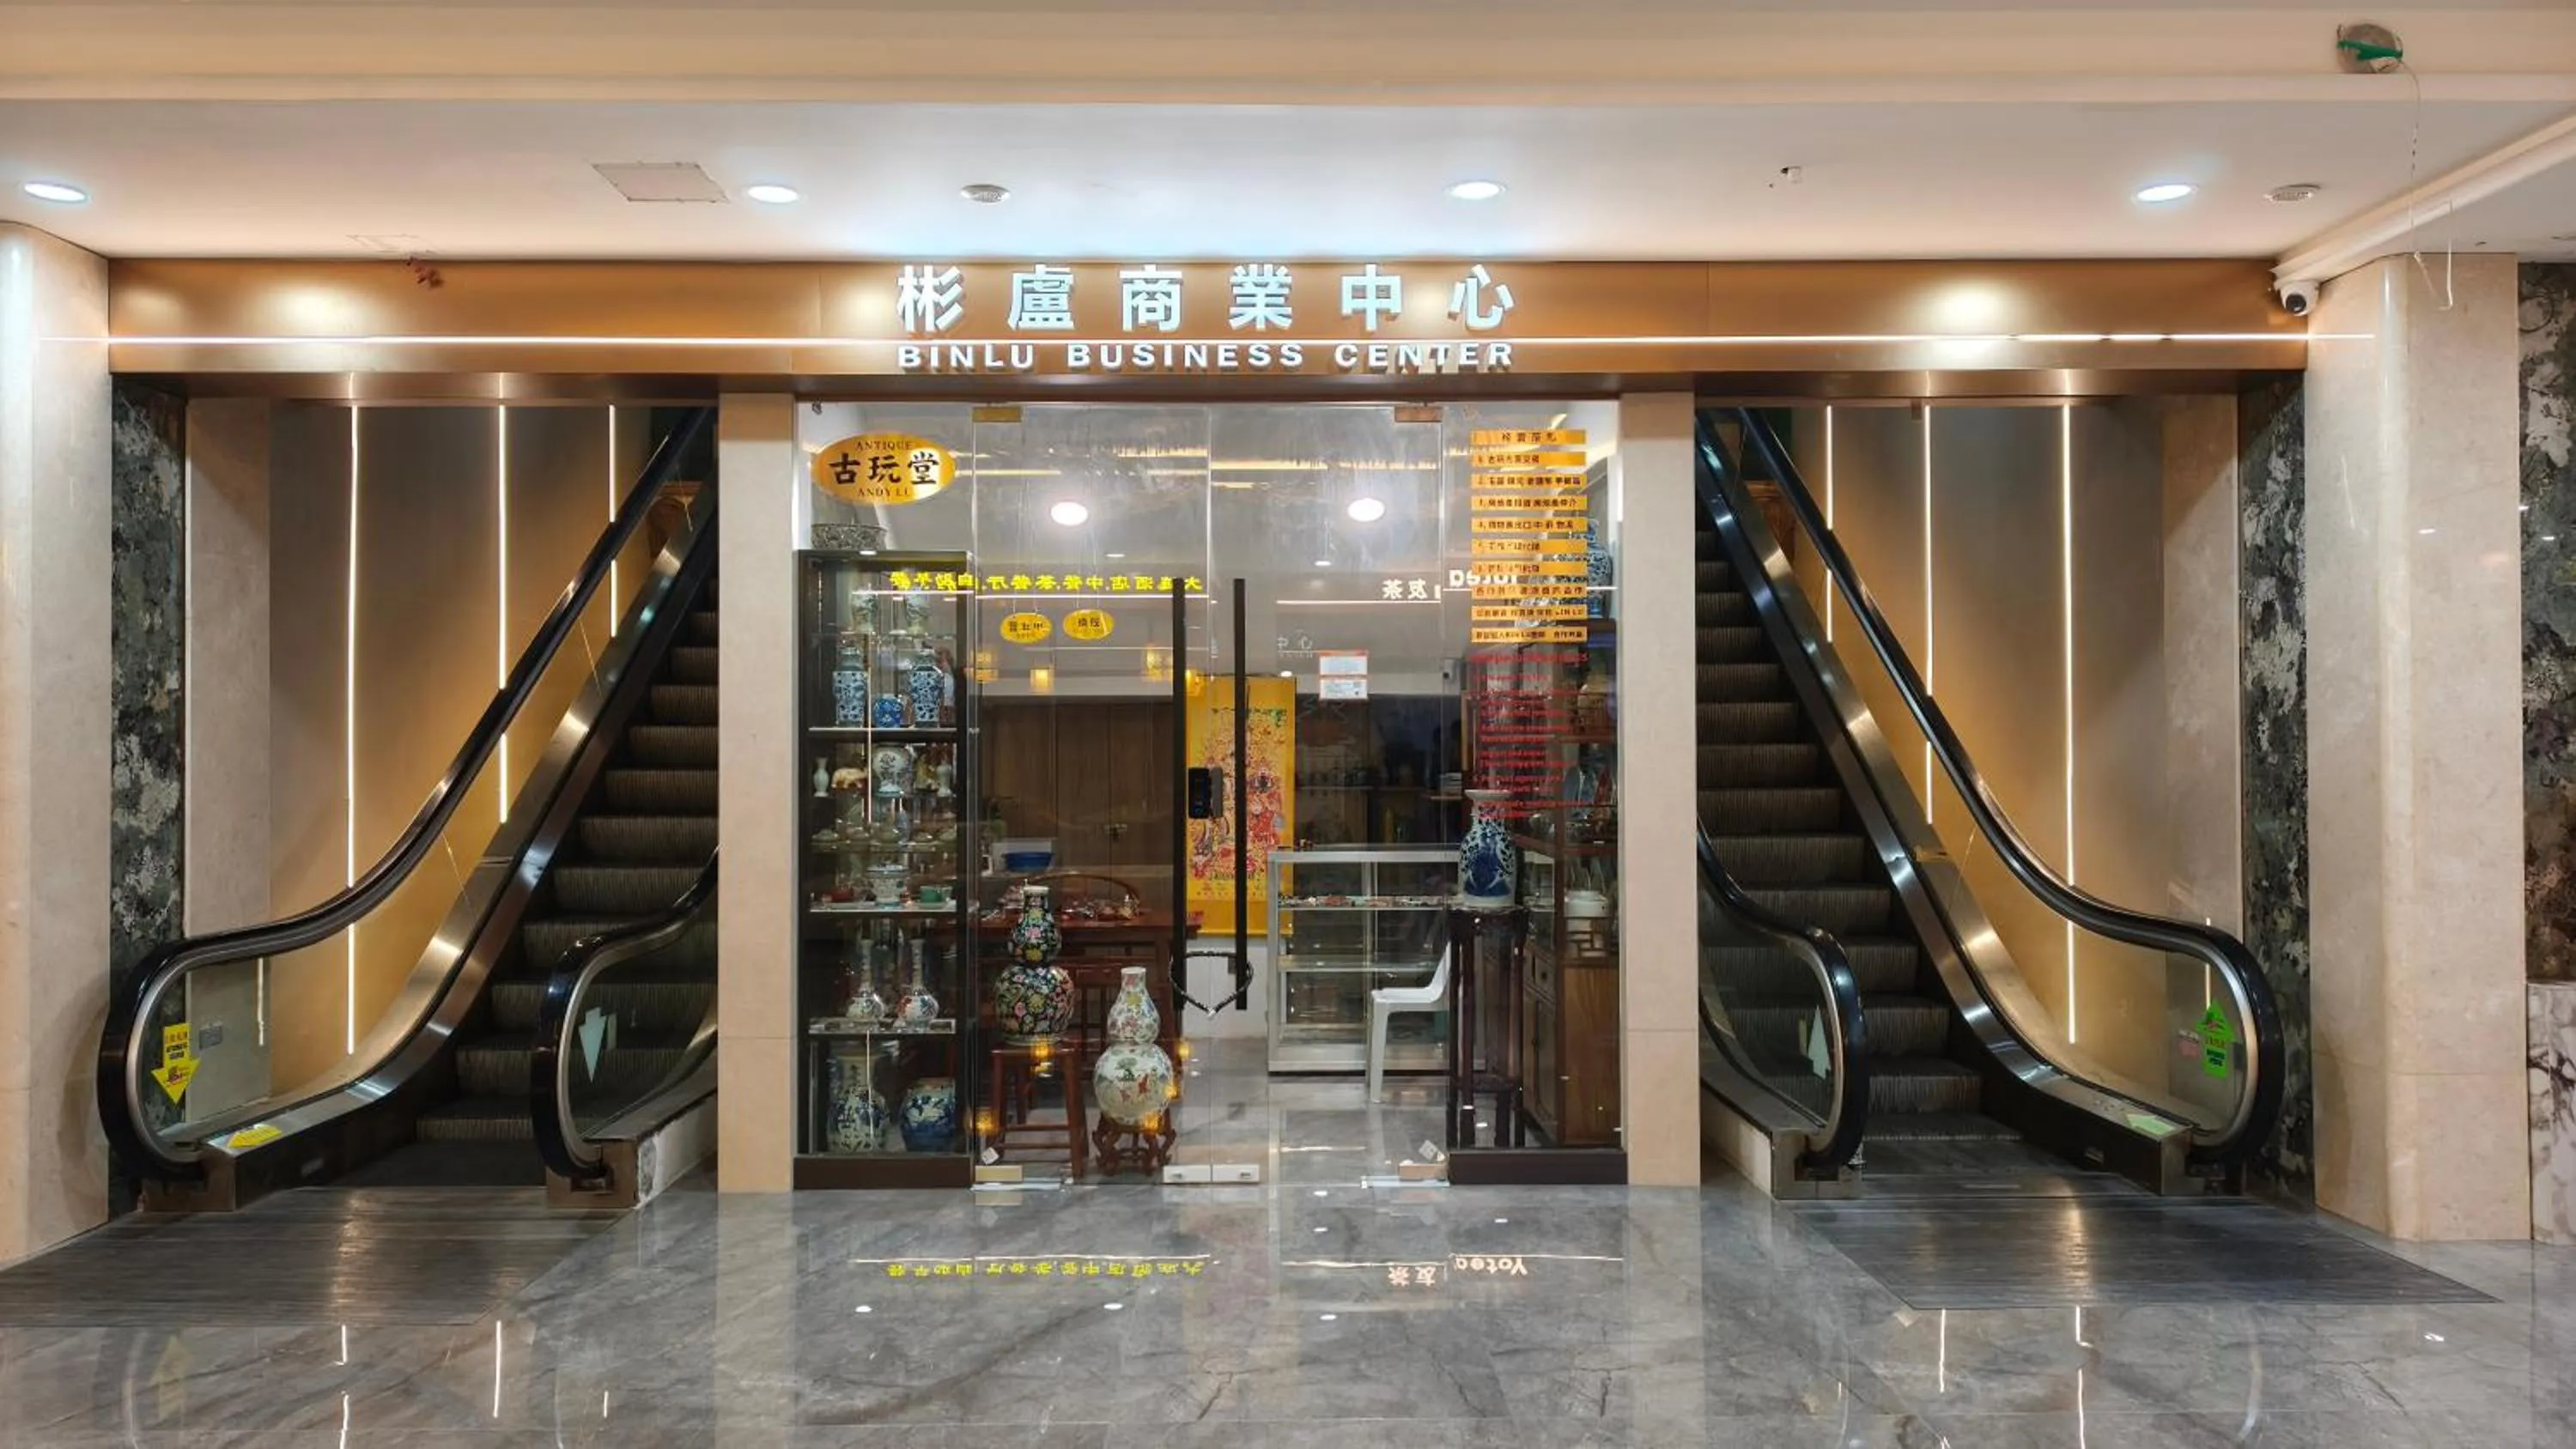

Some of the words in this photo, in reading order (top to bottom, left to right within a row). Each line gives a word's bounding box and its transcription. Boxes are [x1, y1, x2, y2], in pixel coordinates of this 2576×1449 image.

[897, 264, 1515, 332] 彬盧商業中心
[898, 344, 1034, 368] BINLU
[1067, 344, 1303, 369] BUSINESS
[1334, 343, 1513, 367] CENTER
[854, 440, 914, 452] ANTIQUE
[829, 452, 941, 485] 古玩堂
[857, 486, 891, 497] ANDY
